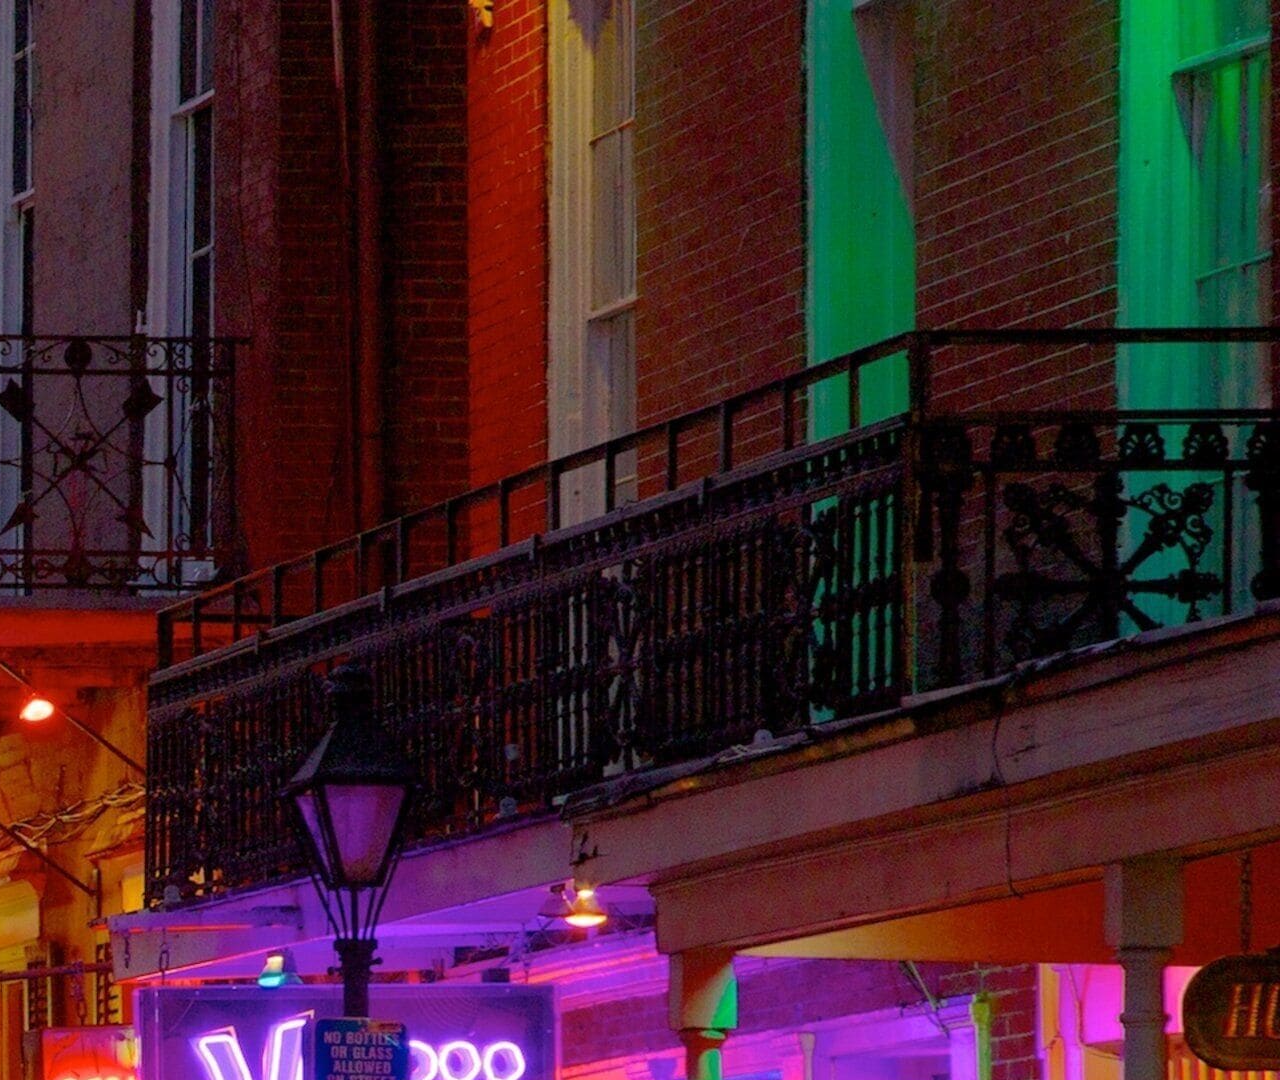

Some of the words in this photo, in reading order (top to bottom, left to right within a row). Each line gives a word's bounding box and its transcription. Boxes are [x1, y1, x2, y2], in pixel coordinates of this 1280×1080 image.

[323, 1031, 341, 1045] NO
[330, 1045, 347, 1059] OR
[352, 1046, 393, 1060] GLASS
[332, 1060, 392, 1074] ALLOWED
